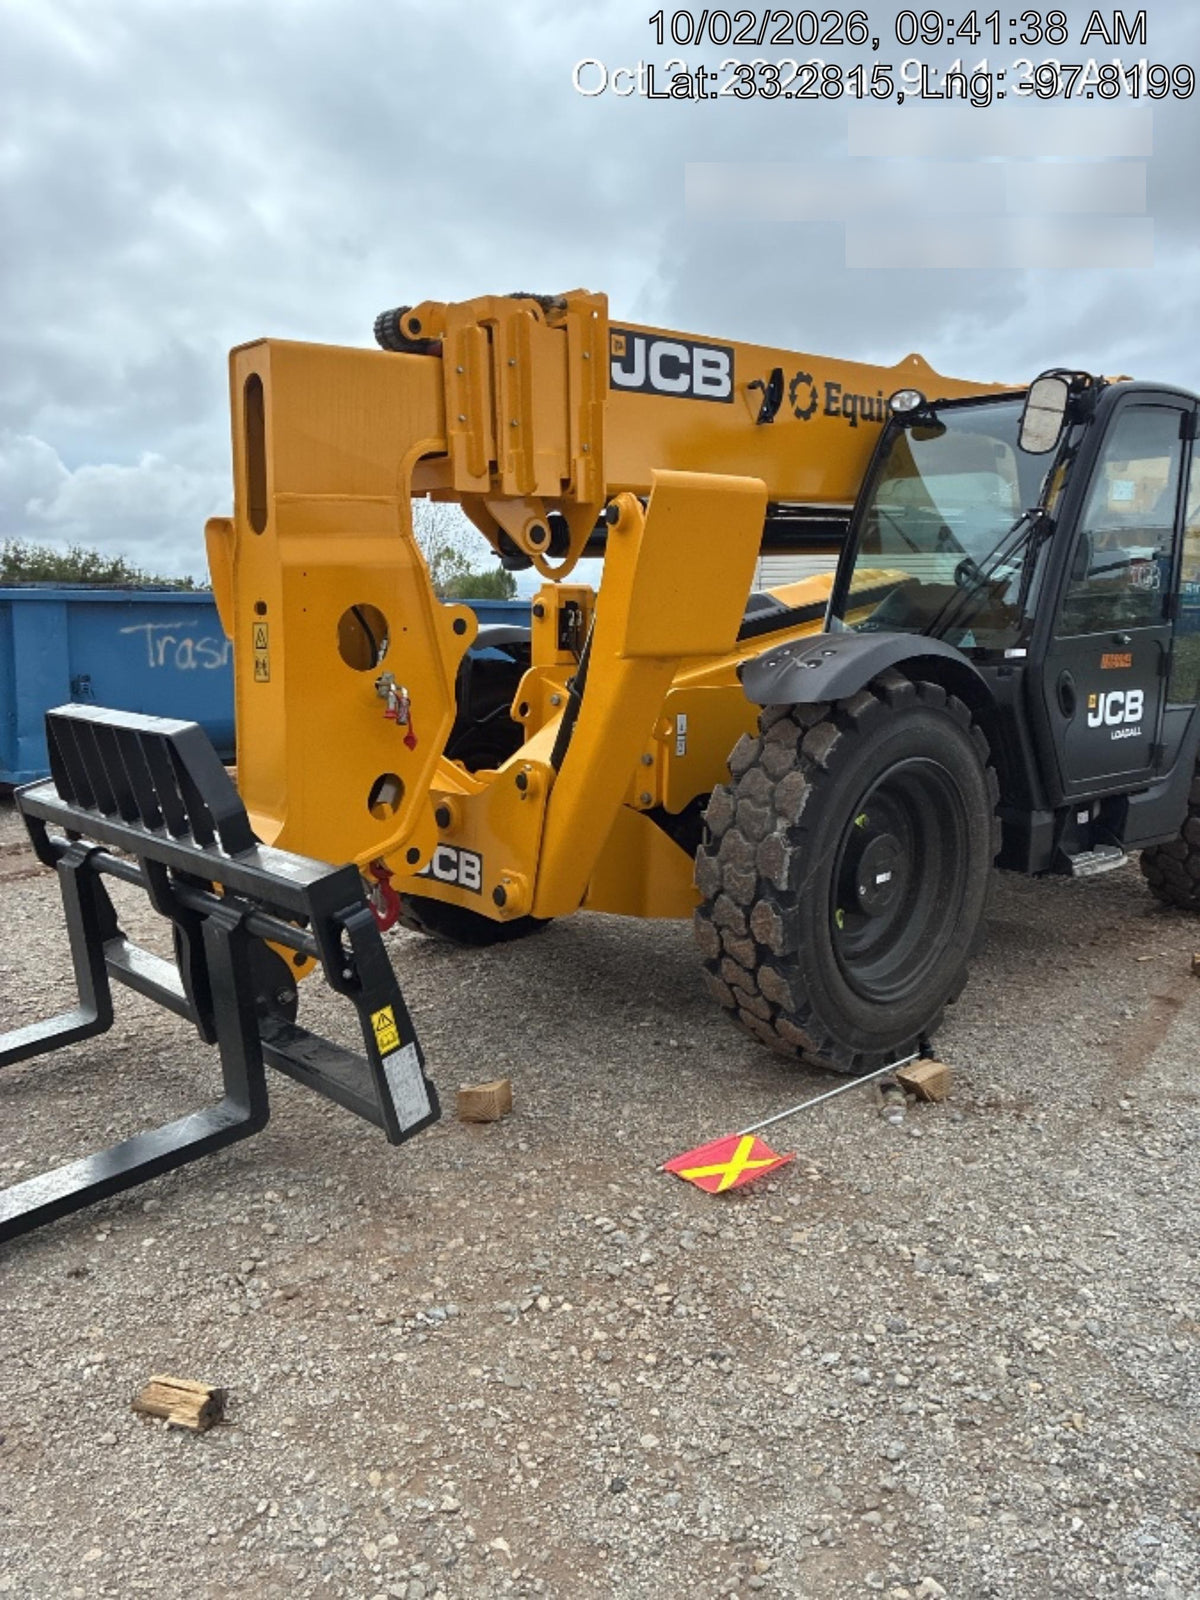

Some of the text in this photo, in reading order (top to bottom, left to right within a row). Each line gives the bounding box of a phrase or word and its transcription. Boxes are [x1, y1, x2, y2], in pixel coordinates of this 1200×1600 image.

[610, 336, 731, 398] JCB
[1087, 689, 1144, 728] JCB
[417, 845, 481, 890] CB
